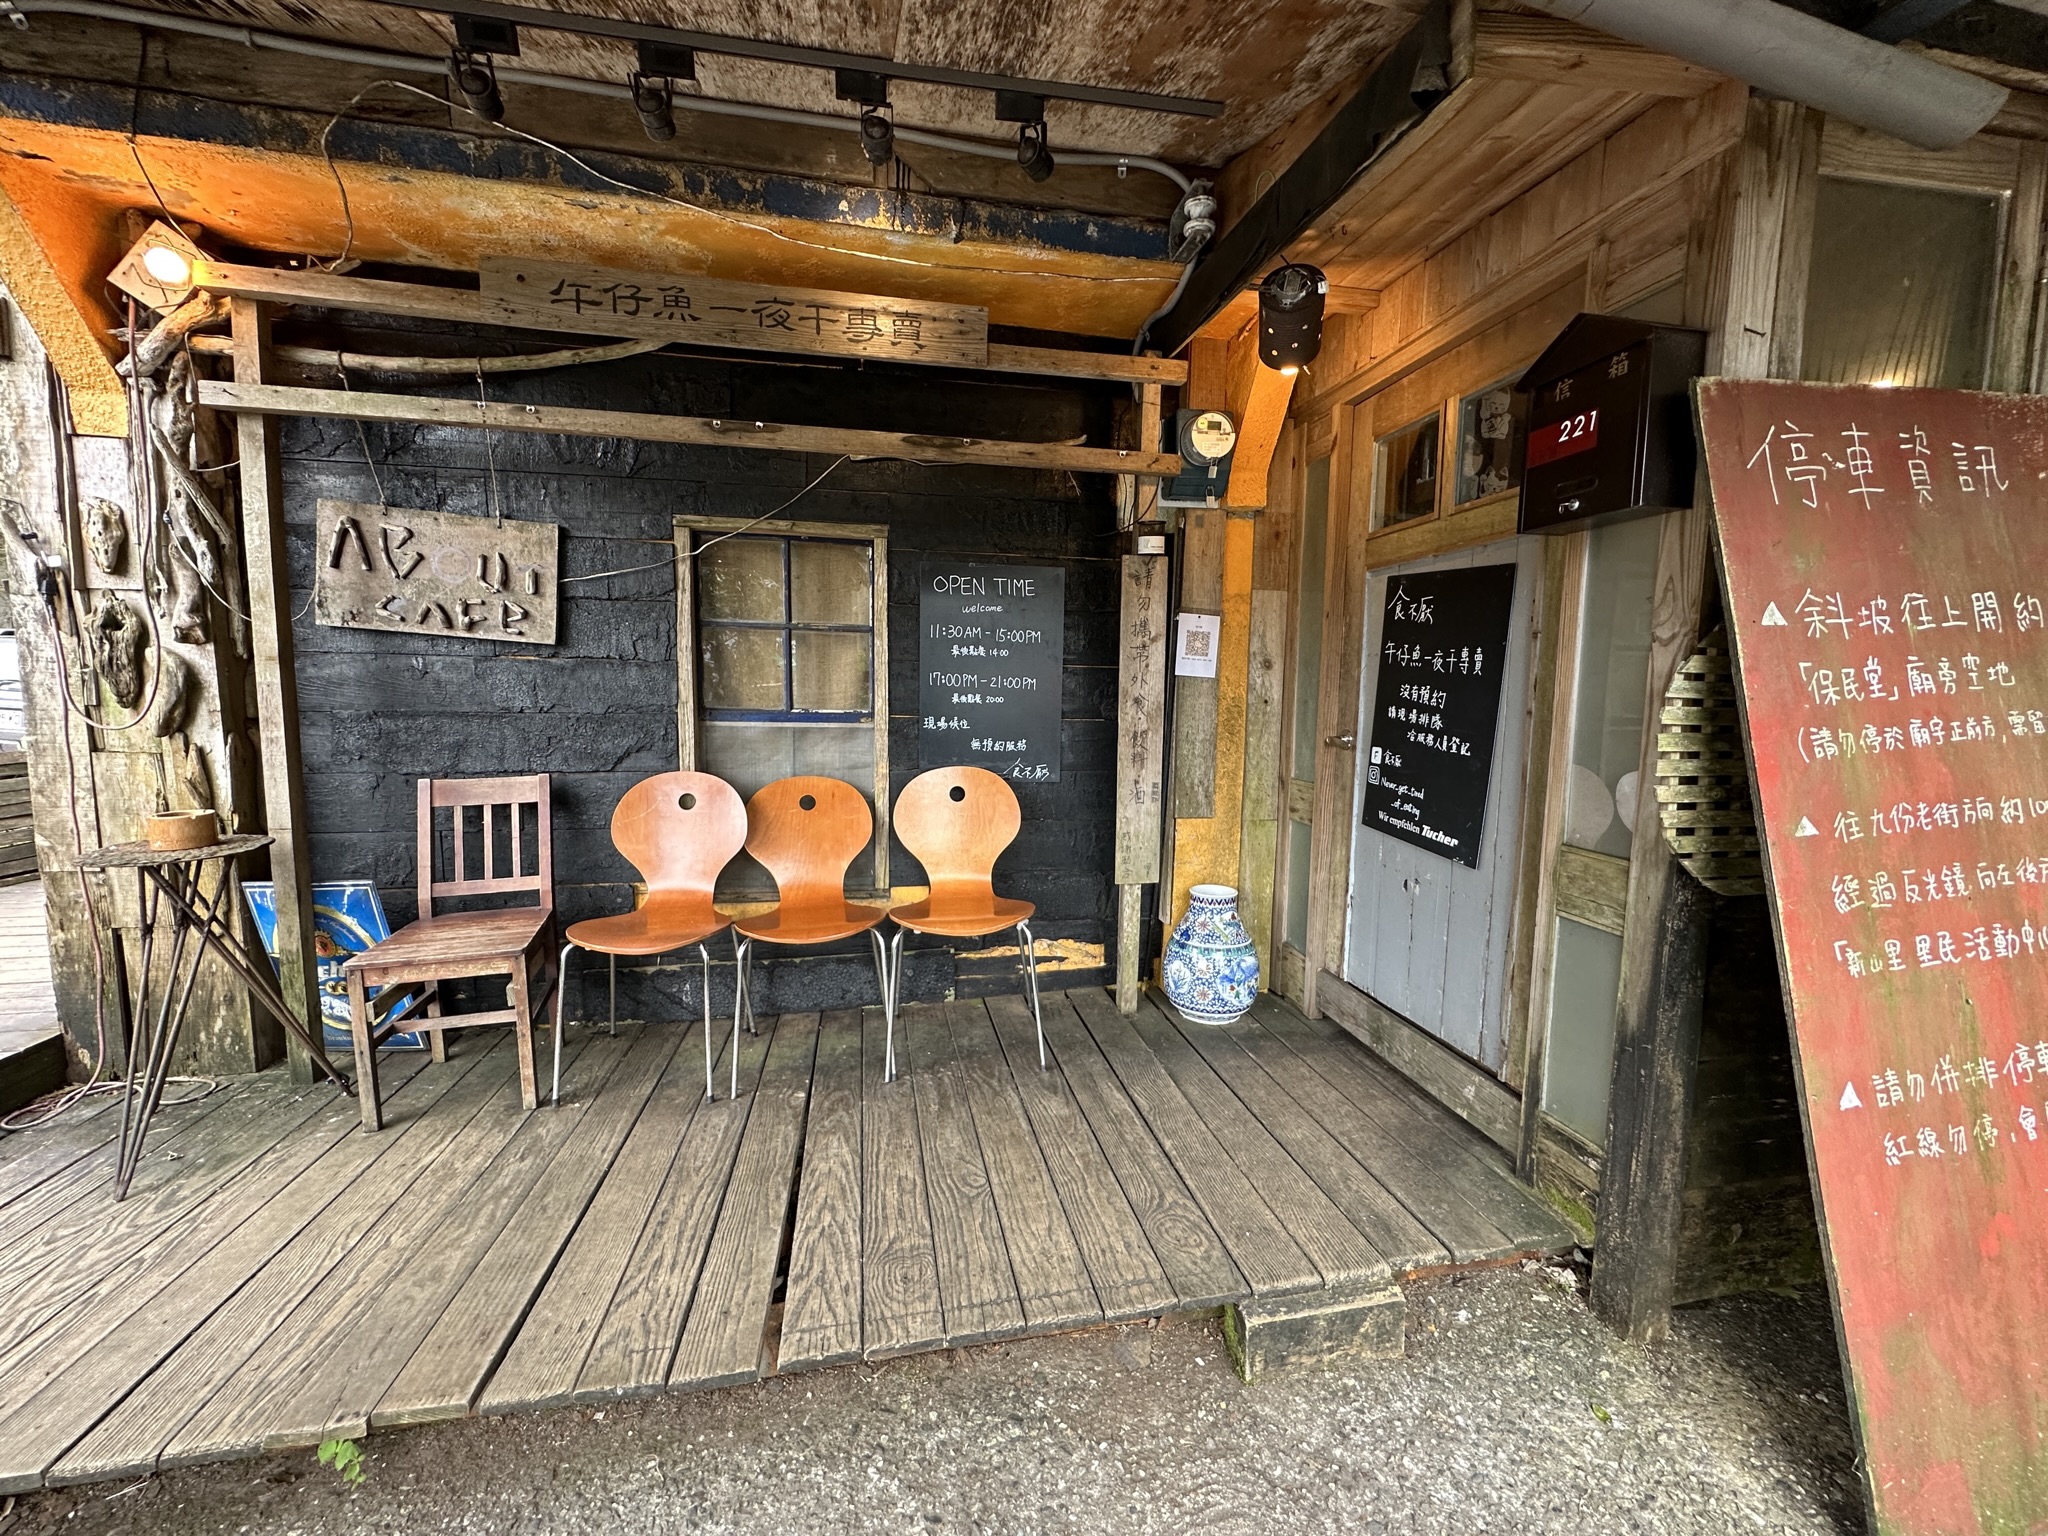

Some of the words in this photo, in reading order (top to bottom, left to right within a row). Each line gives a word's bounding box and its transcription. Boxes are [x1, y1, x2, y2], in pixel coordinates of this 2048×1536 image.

[550, 278, 927, 350] 午仔魚一夜干專賣
[1554, 352, 1629, 402] 信箱
[1558, 410, 1597, 443] 221
[1747, 420, 2009, 510] 停車資訊
[933, 575, 986, 596] OPEN
[993, 577, 1036, 598] TIME
[961, 603, 1004, 614] welcome
[1795, 588, 2044, 640] 斜坡往上開約
[1385, 640, 1483, 675] 午仔魚一夜干專賣
[1399, 683, 1447, 709] 沒有預約
[1798, 652, 2015, 706] 「保民堂」廟旁空地
[922, 716, 971, 731] 現場候位
[1388, 705, 1443, 730] 請現場排隊
[970, 737, 1027, 752] 無預約服務
[1378, 810, 1390, 822] Wir
[1389, 816, 1420, 835] empfehlen
[1421, 824, 1459, 848] Tucher
[1833, 796, 2048, 844] 往九份老街方向約10
